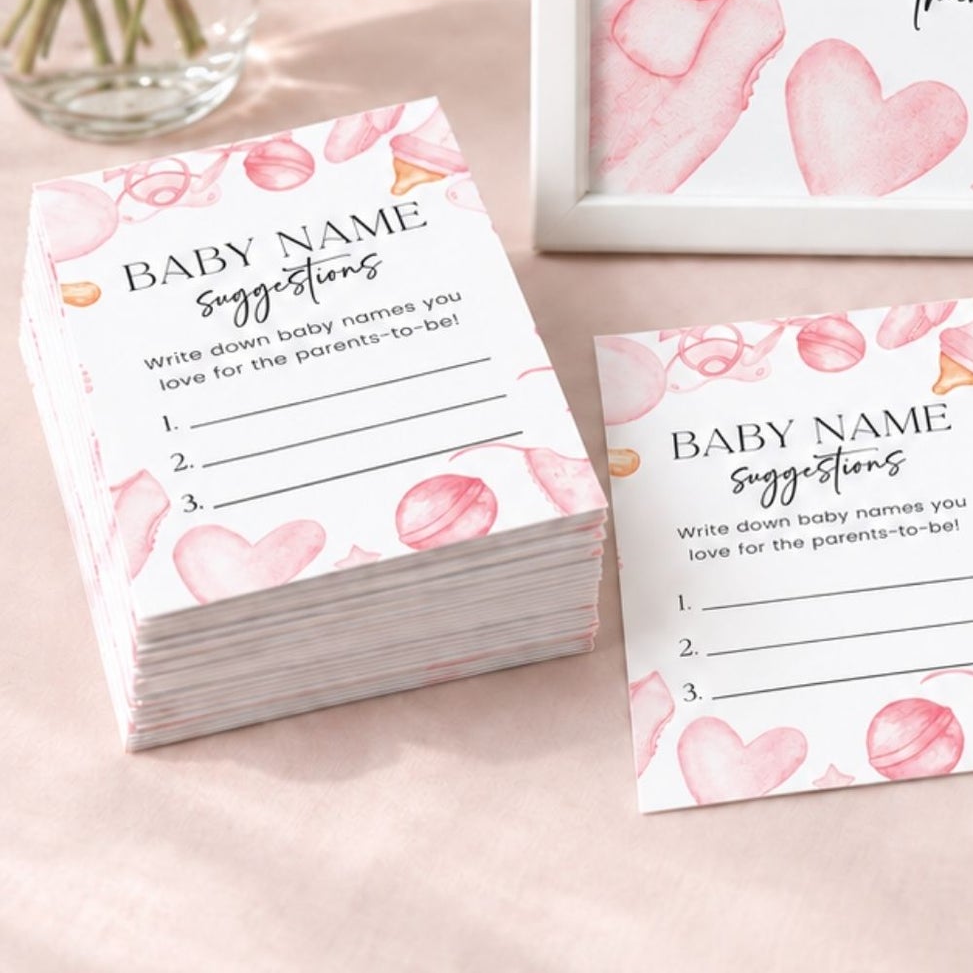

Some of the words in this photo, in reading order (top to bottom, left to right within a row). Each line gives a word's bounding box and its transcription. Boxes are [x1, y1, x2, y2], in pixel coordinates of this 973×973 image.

[122, 237, 253, 292] BABY
[276, 201, 428, 258] NAME
[195, 252, 383, 328] suggestions
[143, 350, 202, 371] Write
[210, 336, 271, 357] down
[276, 320, 333, 342] baby
[341, 303, 416, 327] names
[422, 292, 462, 312] you
[159, 373, 206, 391] love
[212, 364, 243, 379] for
[250, 354, 287, 371] the
[293, 313, 461, 364] parents-to-be!
[162, 415, 179, 432] 1.
[671, 419, 794, 461] BABY
[813, 402, 952, 445] NAME
[170, 452, 194, 473] 2.
[730, 445, 907, 510] suggestions
[183, 493, 204, 513] 3.
[676, 524, 730, 540] Write
[736, 517, 791, 533] down
[797, 510, 849, 526] baby
[855, 502, 924, 519] names
[930, 498, 967, 514] you
[689, 546, 731, 562] love
[738, 540, 765, 555] for
[772, 537, 805, 552] the
[812, 518, 959, 550] parents-to-be!
[678, 593, 692, 612] 1.
[679, 638, 699, 658] 2.
[683, 682, 703, 702] 3.
